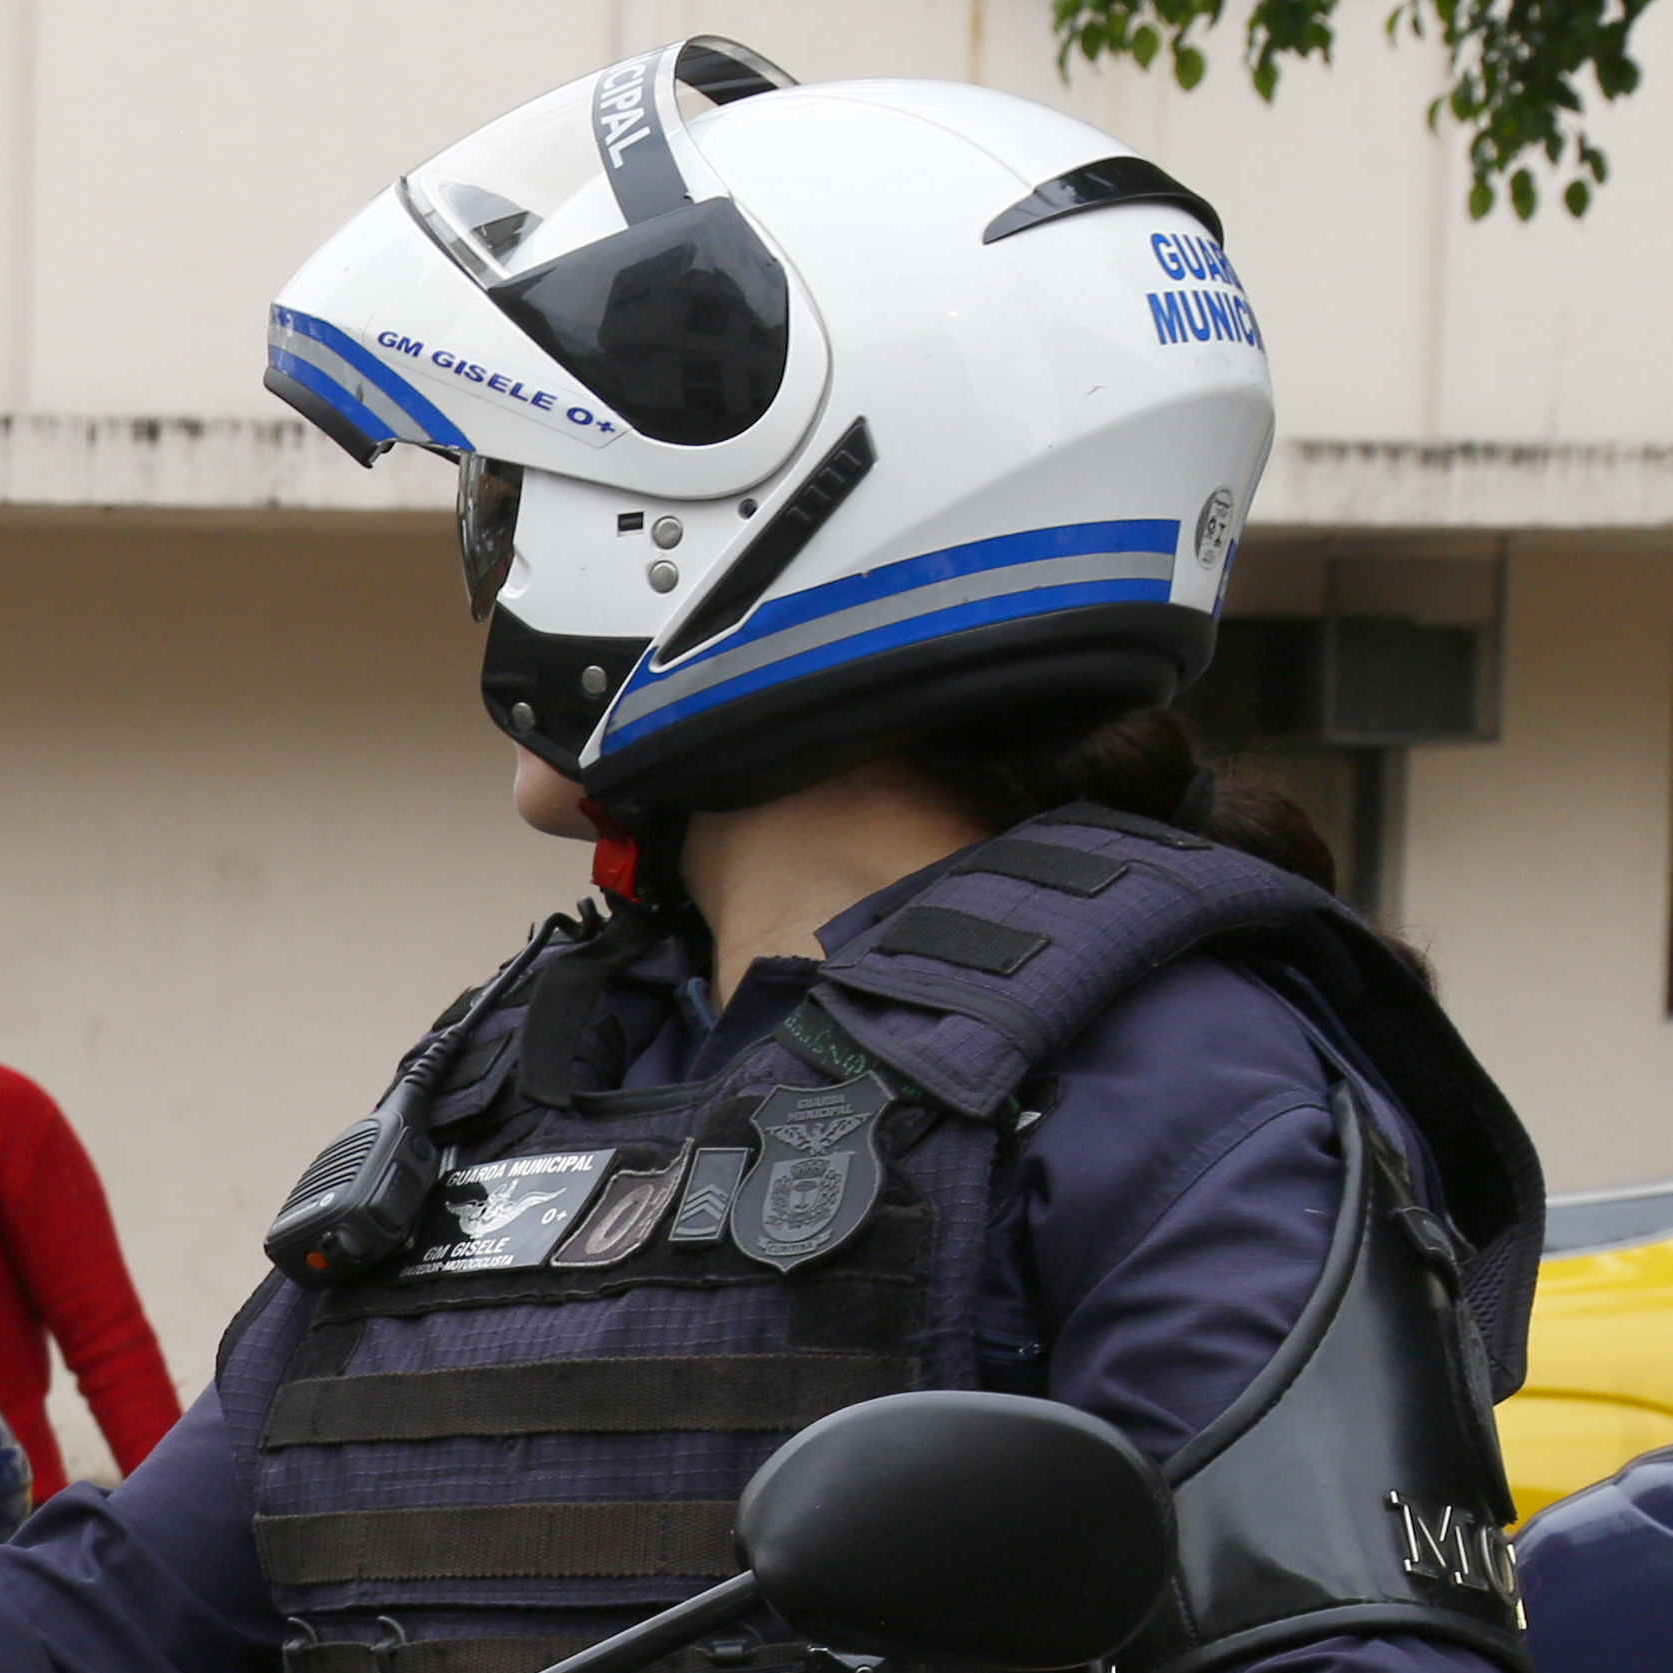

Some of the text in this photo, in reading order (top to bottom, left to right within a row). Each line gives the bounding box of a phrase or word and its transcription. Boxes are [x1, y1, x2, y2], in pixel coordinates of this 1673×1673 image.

[377, 331, 424, 358] GM
[432, 350, 558, 411] GISELE
[446, 1154, 595, 1187] GUARDA MUNICIPAL
[422, 1237, 511, 1262] GM GISELE
